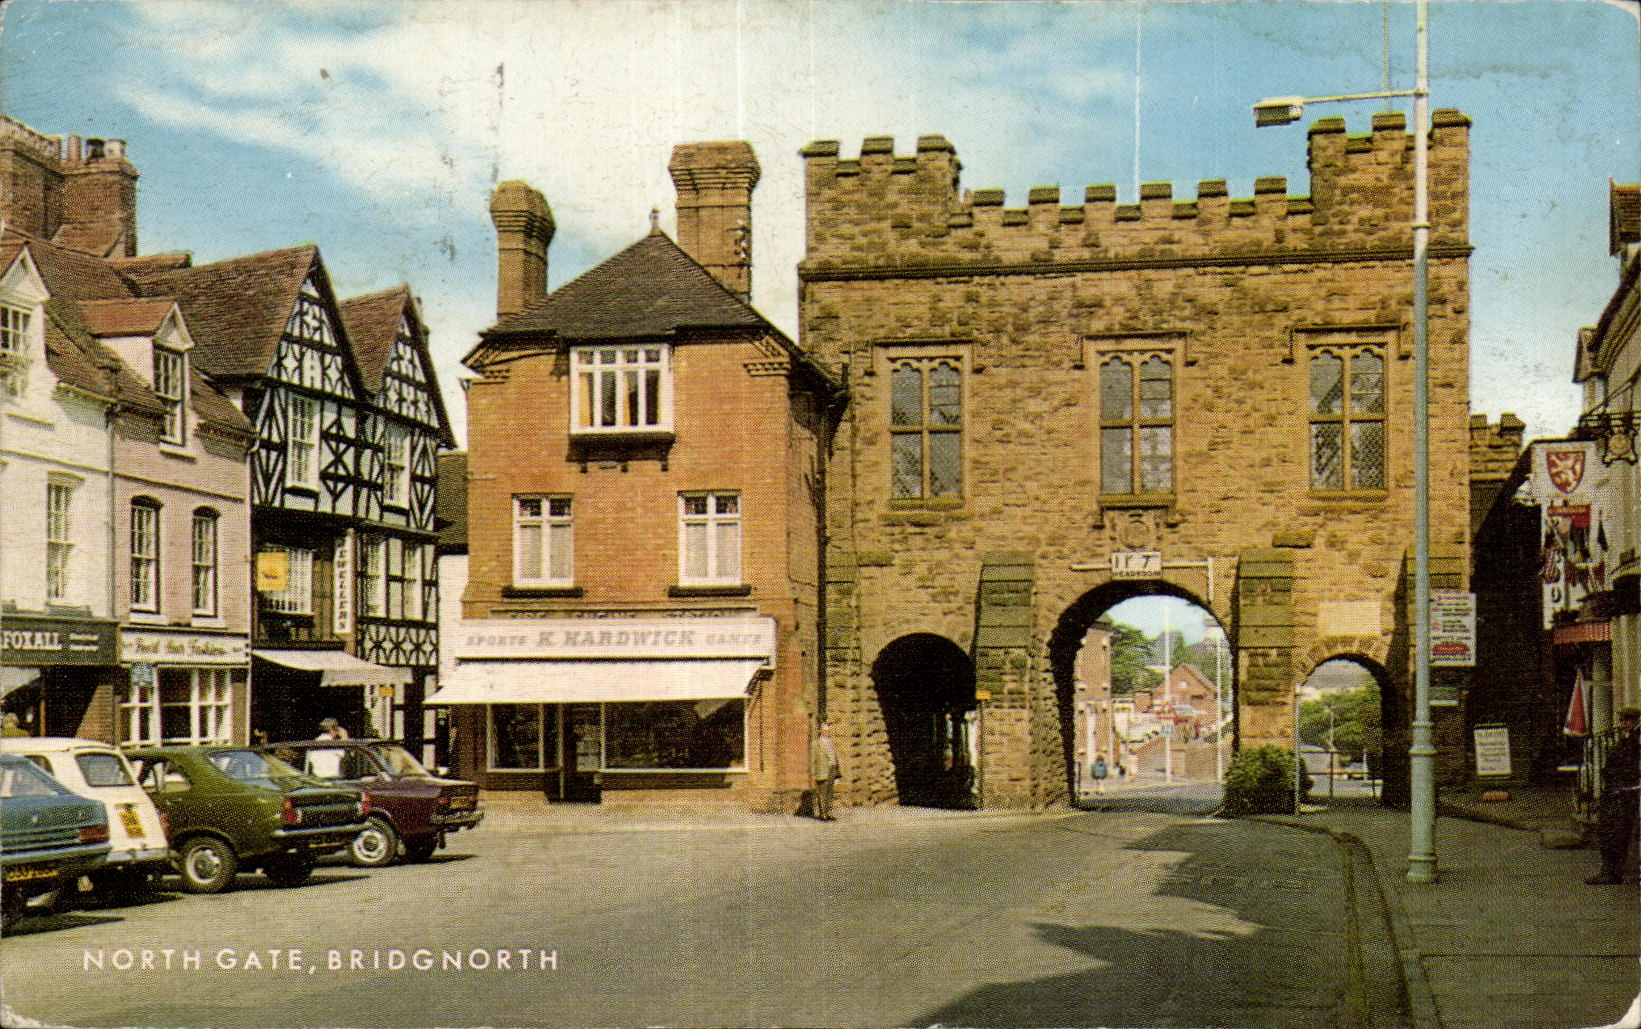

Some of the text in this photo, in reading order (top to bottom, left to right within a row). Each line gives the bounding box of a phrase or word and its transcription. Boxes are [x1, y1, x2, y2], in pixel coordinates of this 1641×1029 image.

[2, 630, 62, 651] FOXALL
[466, 631, 762, 647] SPORTS K HARDWICK GAMES
